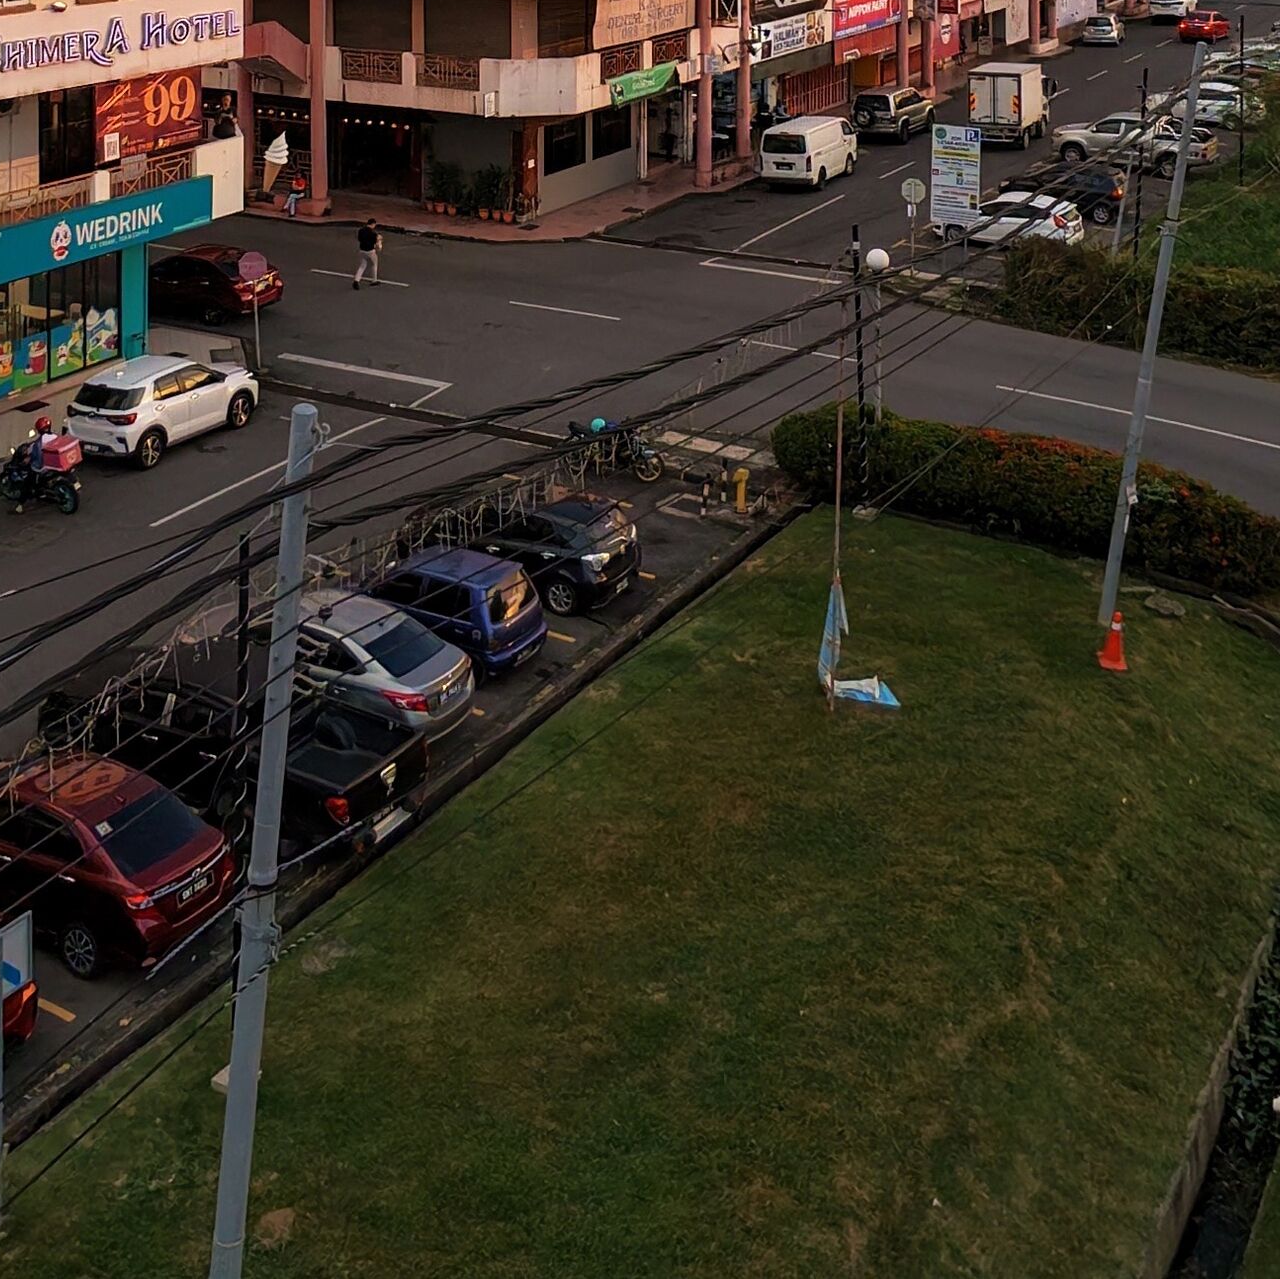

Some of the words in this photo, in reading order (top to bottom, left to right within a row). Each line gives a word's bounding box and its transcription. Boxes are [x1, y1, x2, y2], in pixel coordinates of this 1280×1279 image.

[141, 10, 242, 51] HOTEL
[848, 4, 871, 19] NIPPON
[75, 202, 163, 246] WEDRINK
